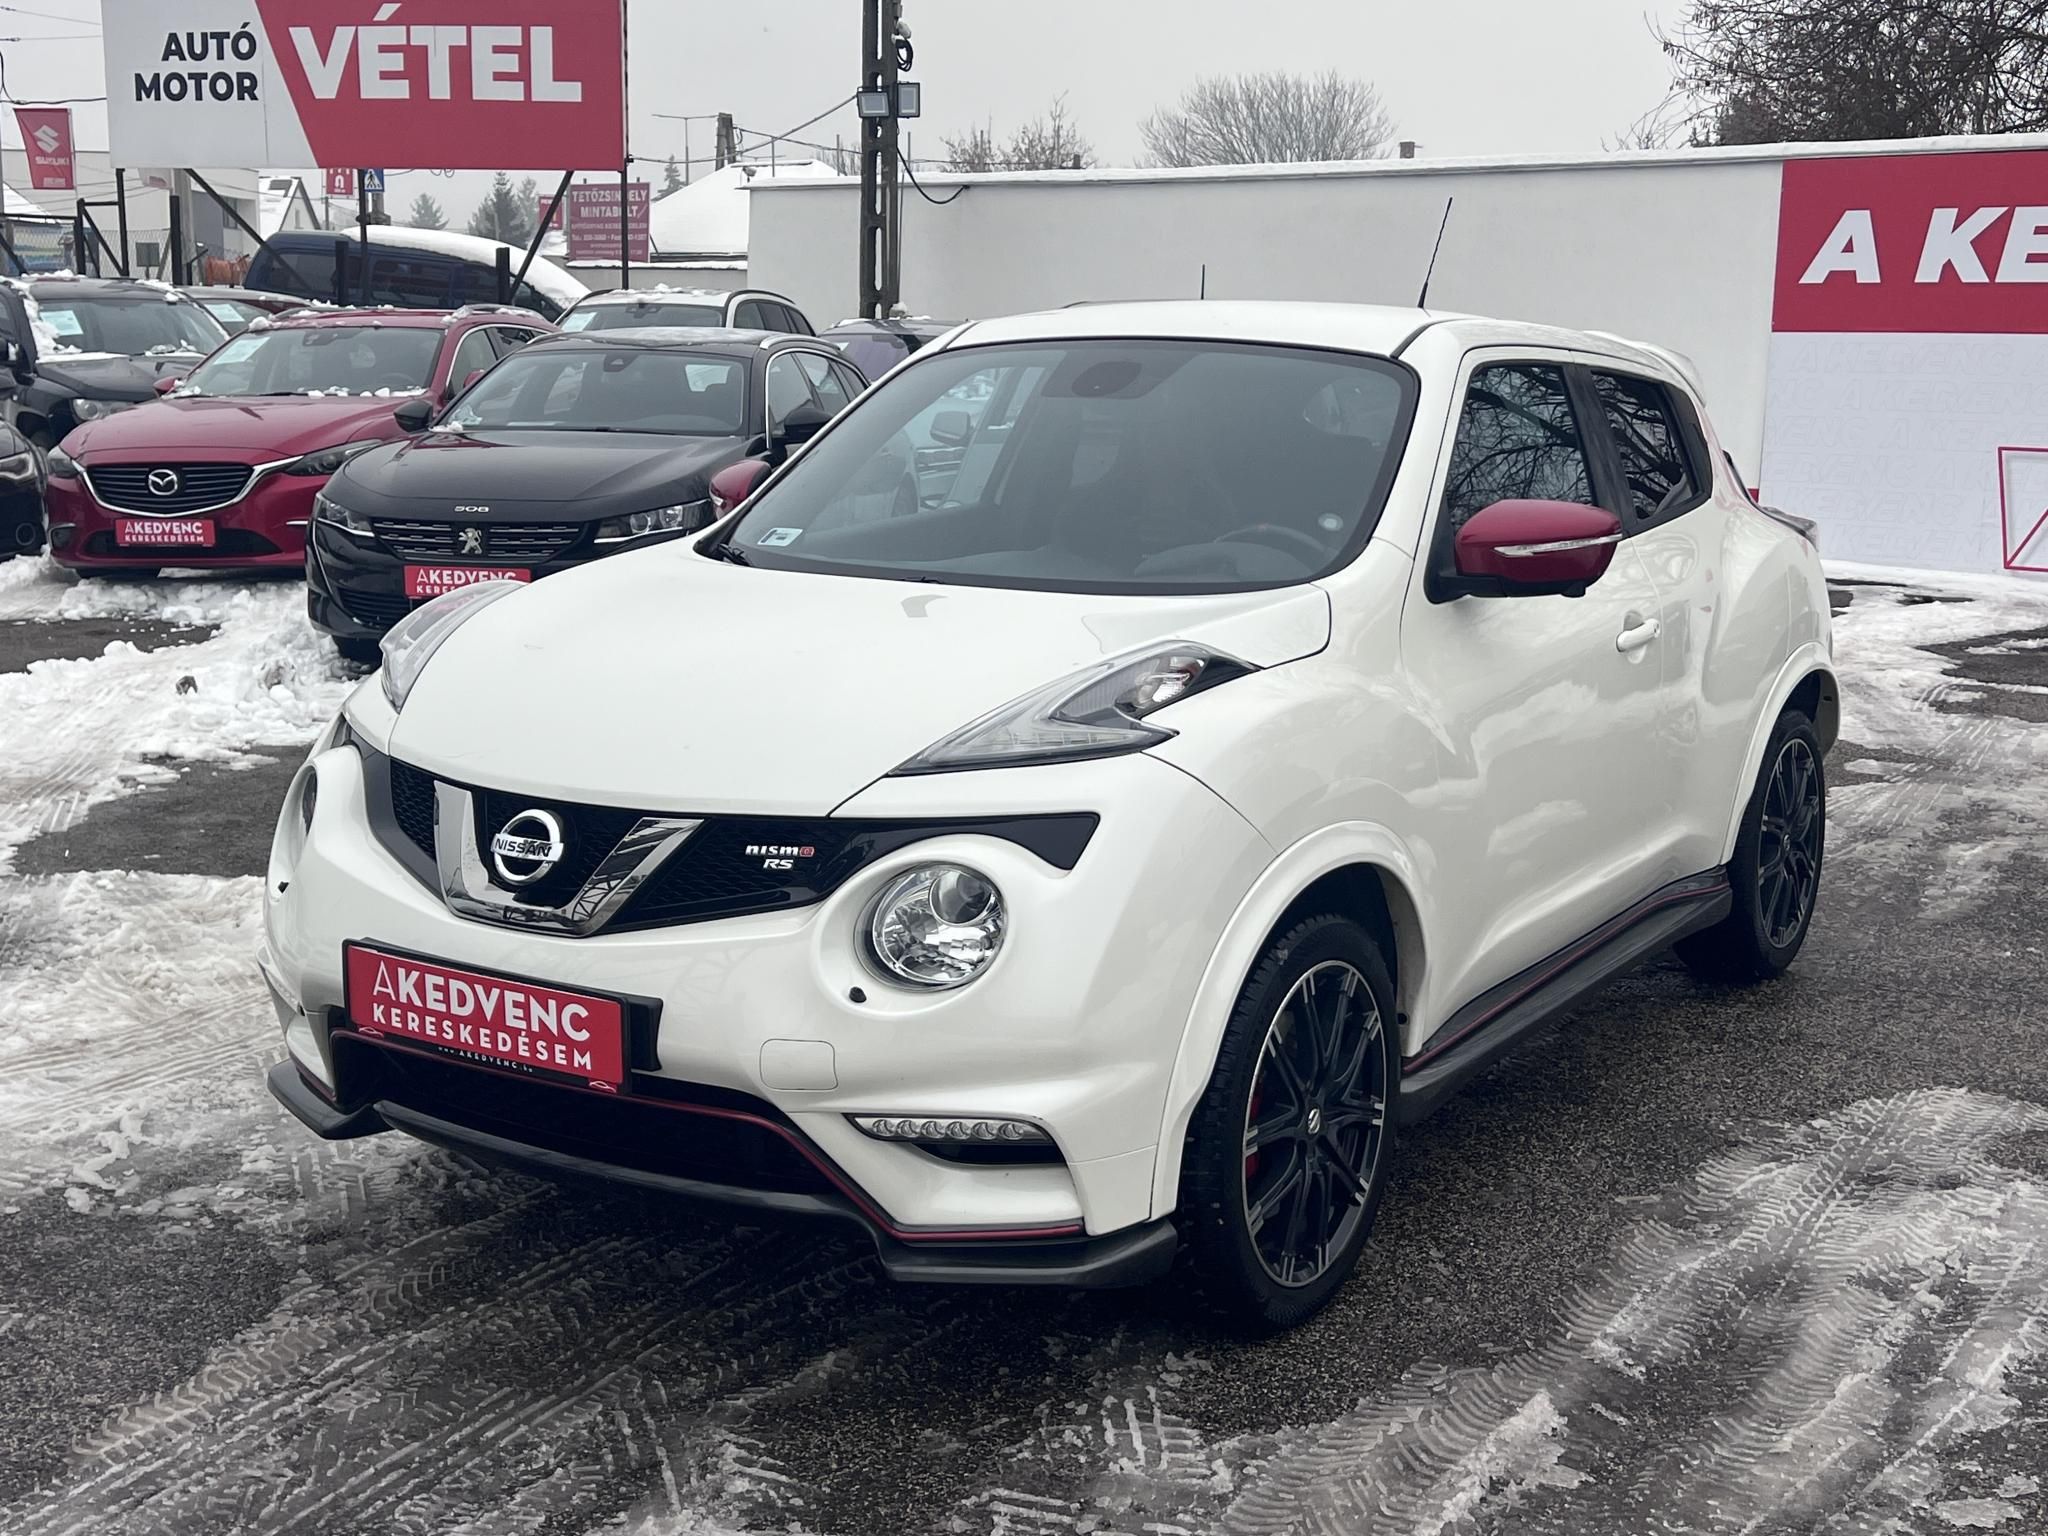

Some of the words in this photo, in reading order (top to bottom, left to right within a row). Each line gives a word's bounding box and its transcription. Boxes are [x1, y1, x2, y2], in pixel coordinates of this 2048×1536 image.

[161, 22, 257, 61] AUTÓ
[288, 2, 582, 102] VÉTEL
[134, 71, 259, 101] MOTOR
[572, 187, 648, 202] TETŐZSINELY
[580, 205, 638, 218] MINTABLT
[1798, 208, 1881, 284] A
[1914, 206, 2048, 283] KE
[495, 838, 552, 857] NISSAN
[763, 859, 794, 869] RS
[372, 960, 591, 1042] AKEDVENC
[372, 1002, 592, 1071] KERESKEDÉSEM
